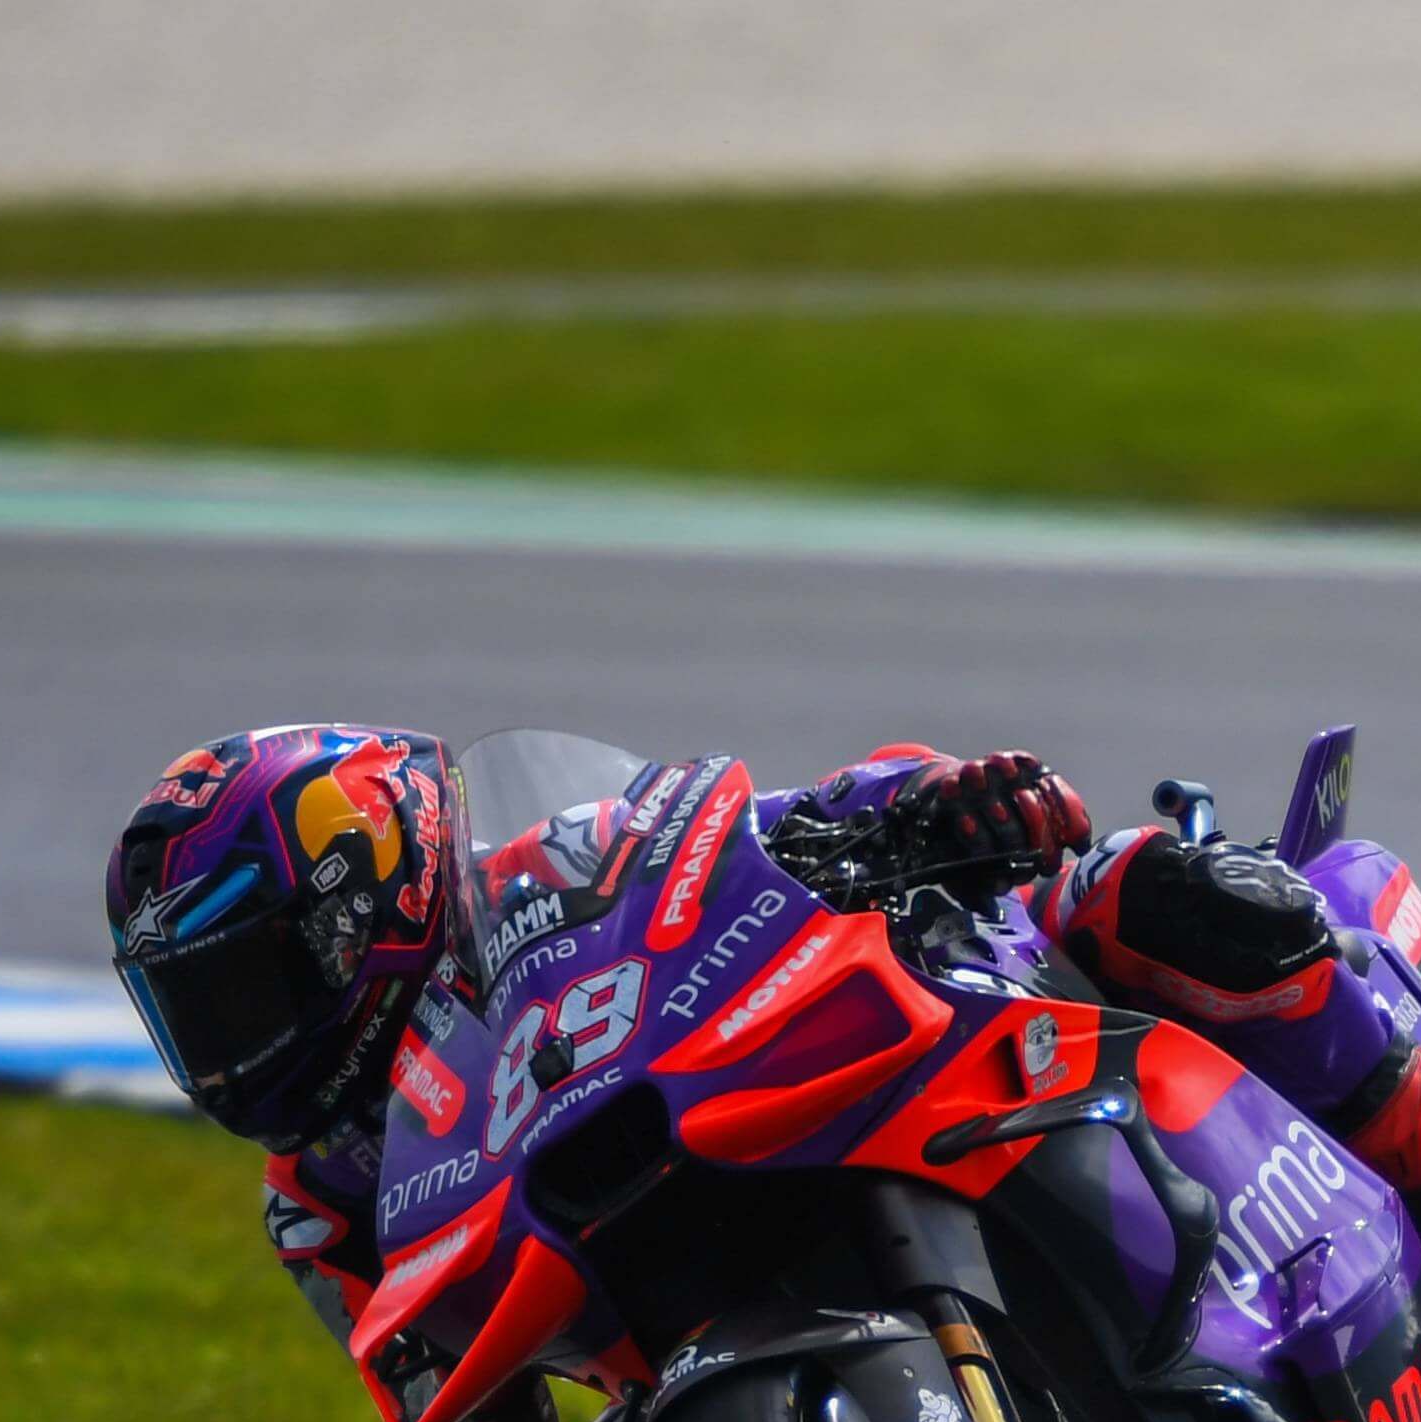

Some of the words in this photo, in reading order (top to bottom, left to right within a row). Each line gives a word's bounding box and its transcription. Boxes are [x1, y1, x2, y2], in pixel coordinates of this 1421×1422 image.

[662, 790, 742, 927] PRAMAC
[484, 892, 564, 976] FIAMM
[494, 938, 578, 1021] prima
[661, 888, 787, 1020] prima
[718, 932, 831, 1041] MOTUL
[398, 1046, 453, 1116] PRAMAC
[484, 958, 648, 1157] 89
[521, 1067, 623, 1154] PRAMAC
[381, 1149, 479, 1235] prima
[1210, 1120, 1346, 1329] prima
